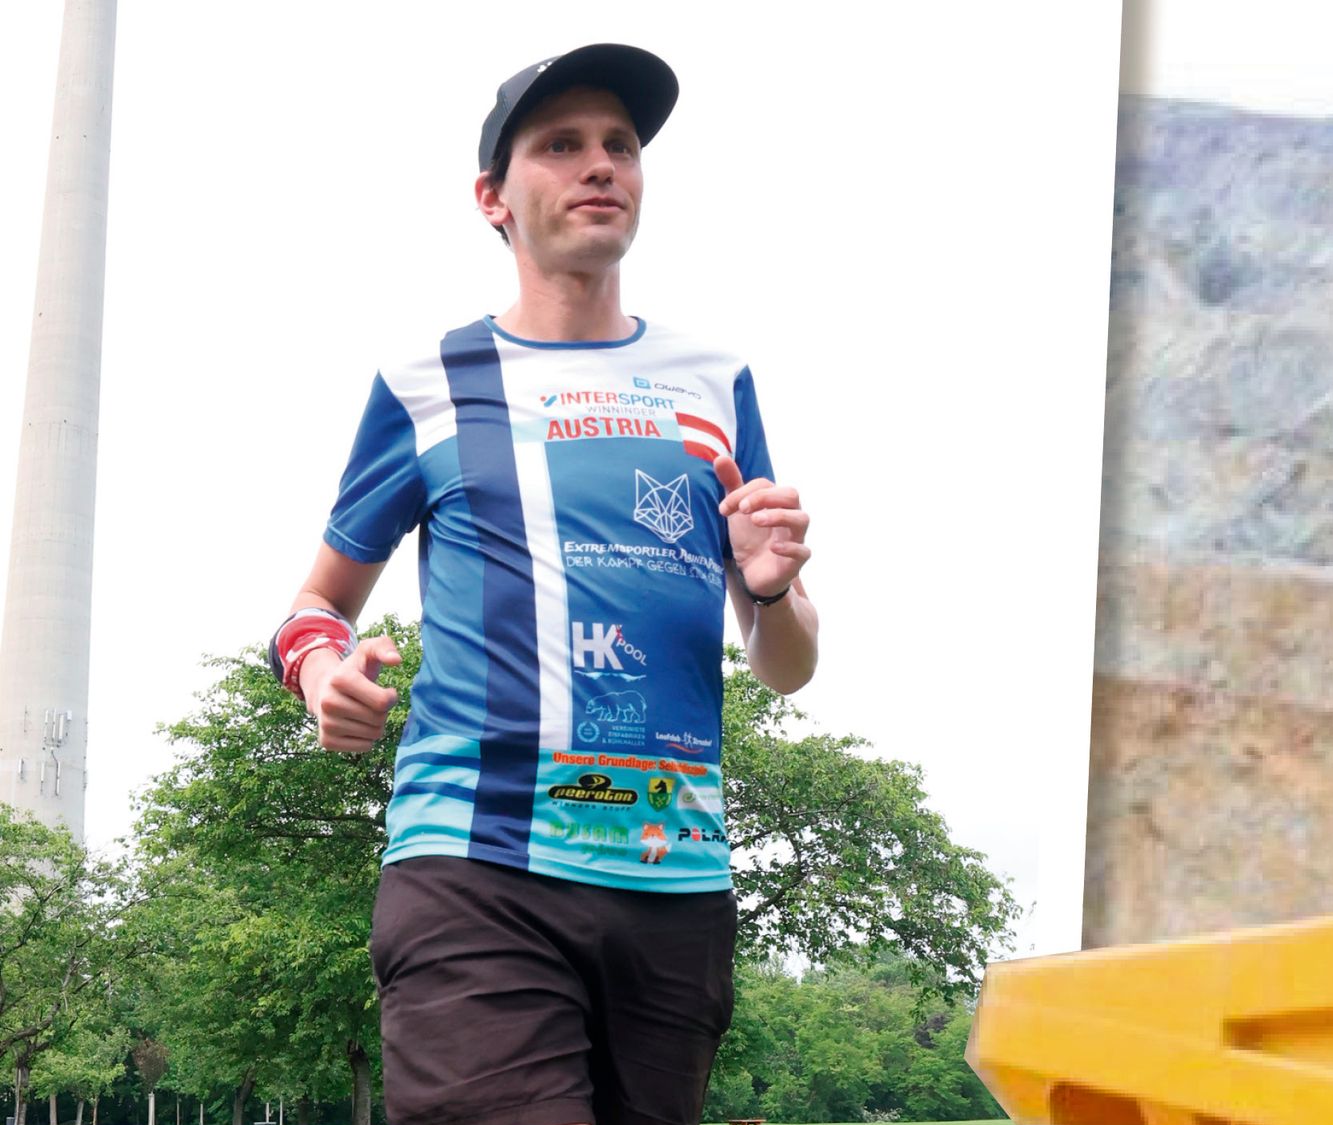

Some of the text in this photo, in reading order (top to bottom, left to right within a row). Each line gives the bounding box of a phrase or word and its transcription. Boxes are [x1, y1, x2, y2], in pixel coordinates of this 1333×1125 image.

[560, 391, 675, 410] INTERSPORT
[547, 416, 662, 440] AUSTRIA
[566, 556, 593, 567] DER
[572, 621, 624, 671] HK
[616, 638, 648, 666] POOL
[553, 751, 595, 766] Unsere
[598, 753, 656, 772] Grundlage:
[553, 787, 634, 803] peeroton
